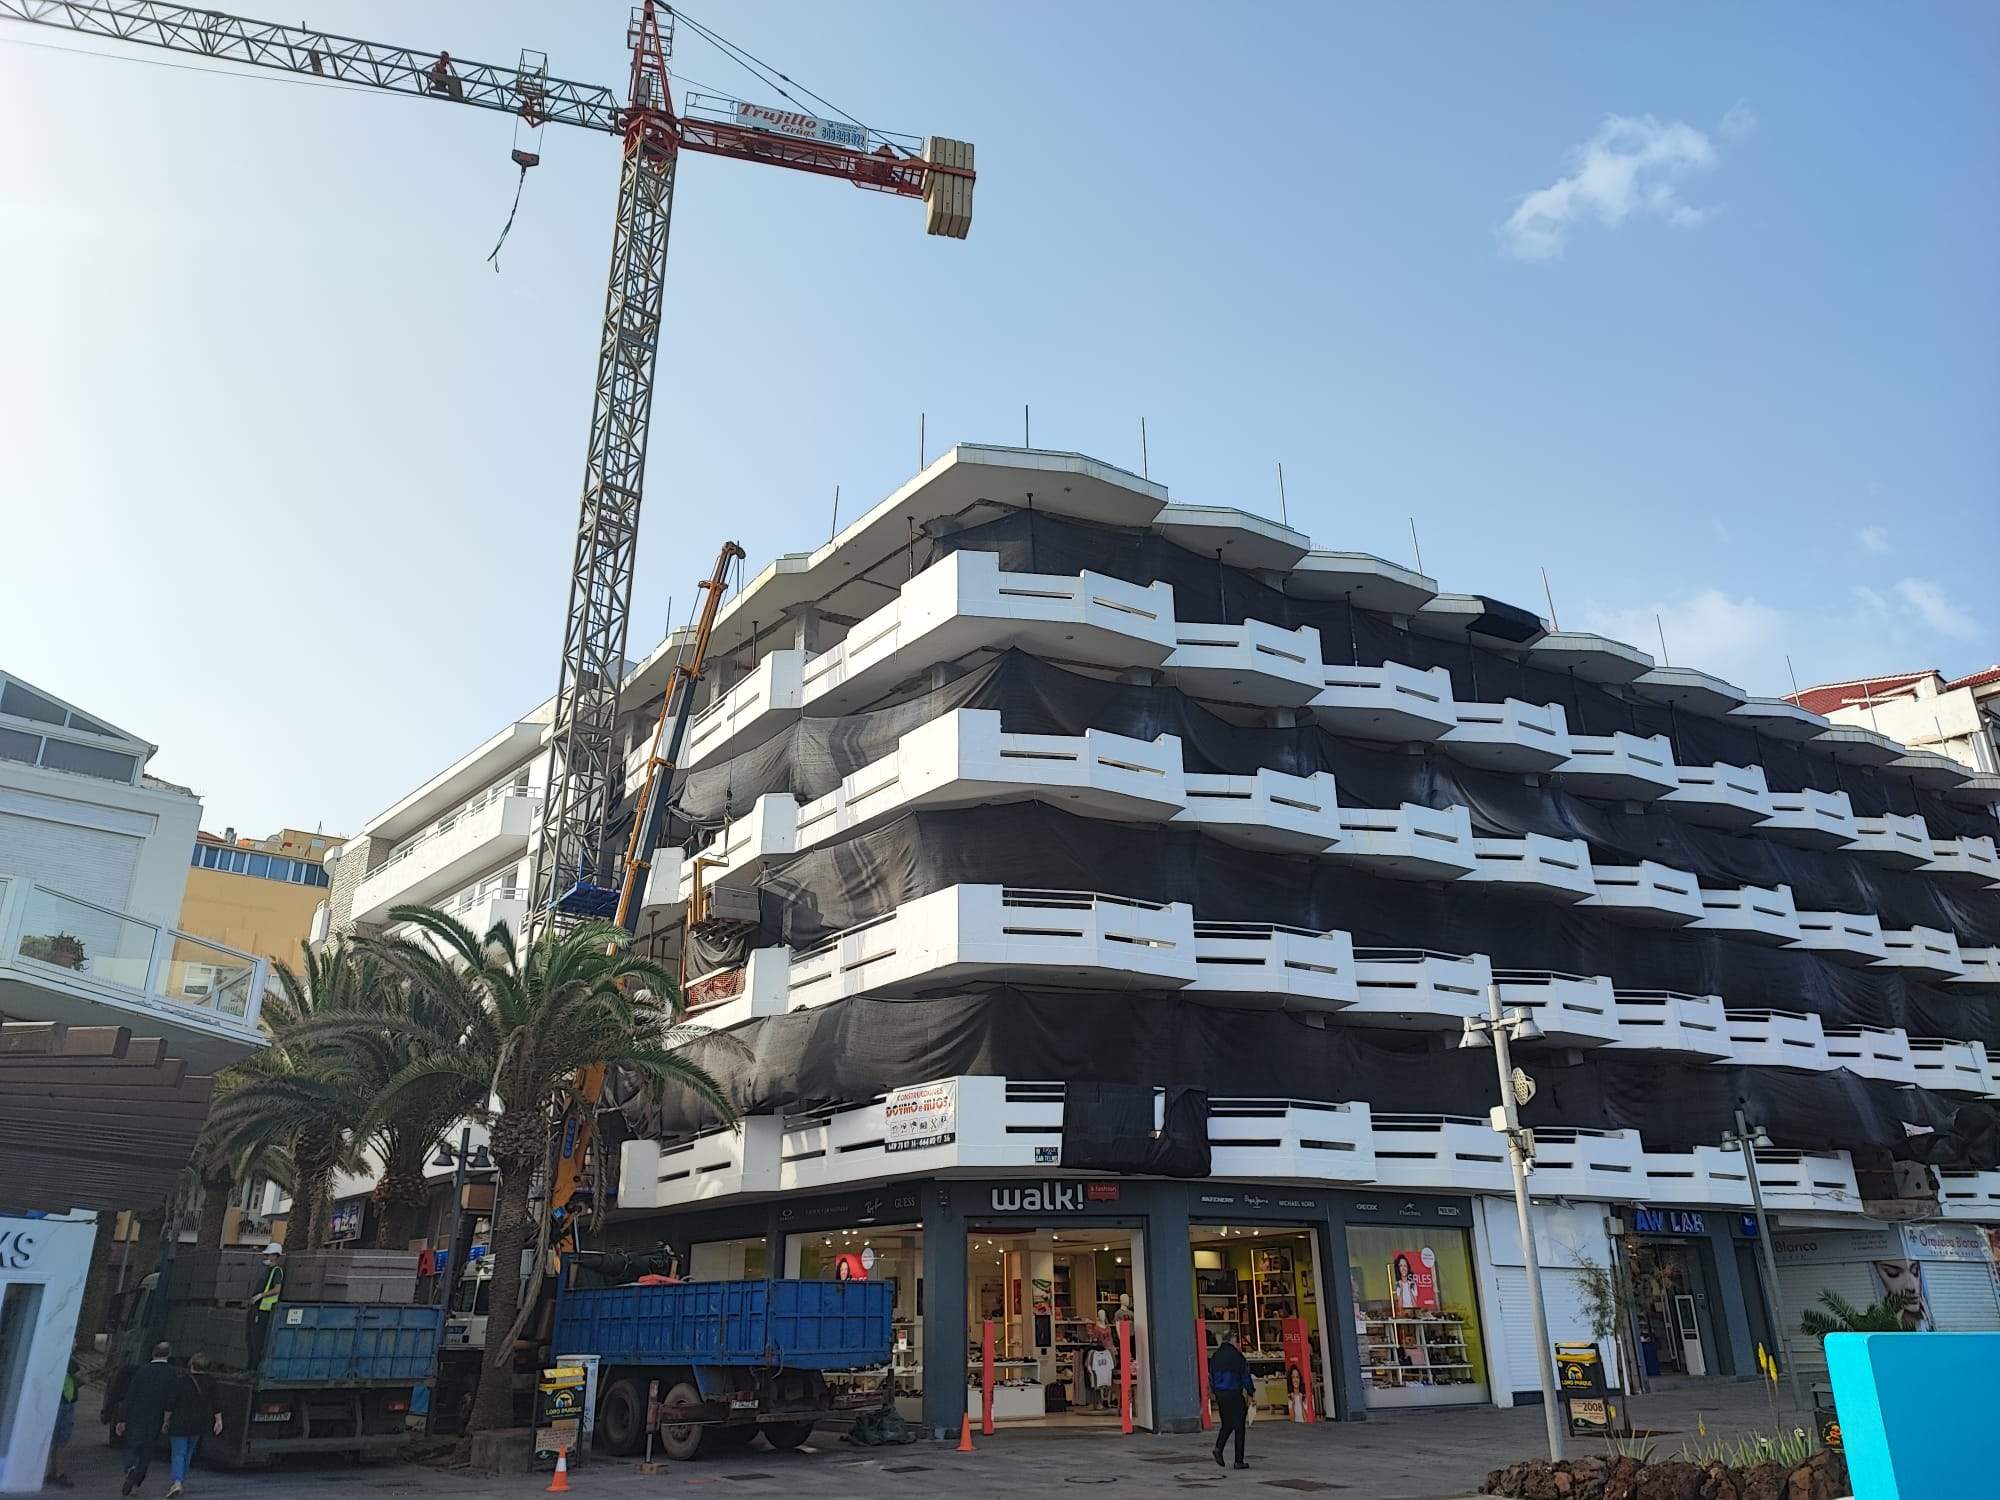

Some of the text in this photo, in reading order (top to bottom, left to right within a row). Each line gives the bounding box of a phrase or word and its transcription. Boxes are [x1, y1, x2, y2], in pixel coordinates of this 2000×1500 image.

[740, 102, 817, 129] Trujillo
[991, 1182, 1084, 1211] walk!
[1636, 1209, 1663, 1232] AW
[1775, 1240, 1818, 1253] Blanca
[1955, 1236, 1979, 1248] Blanca
[1407, 1273, 1432, 1284] SALES
[1583, 1402, 1603, 1412] 2008
